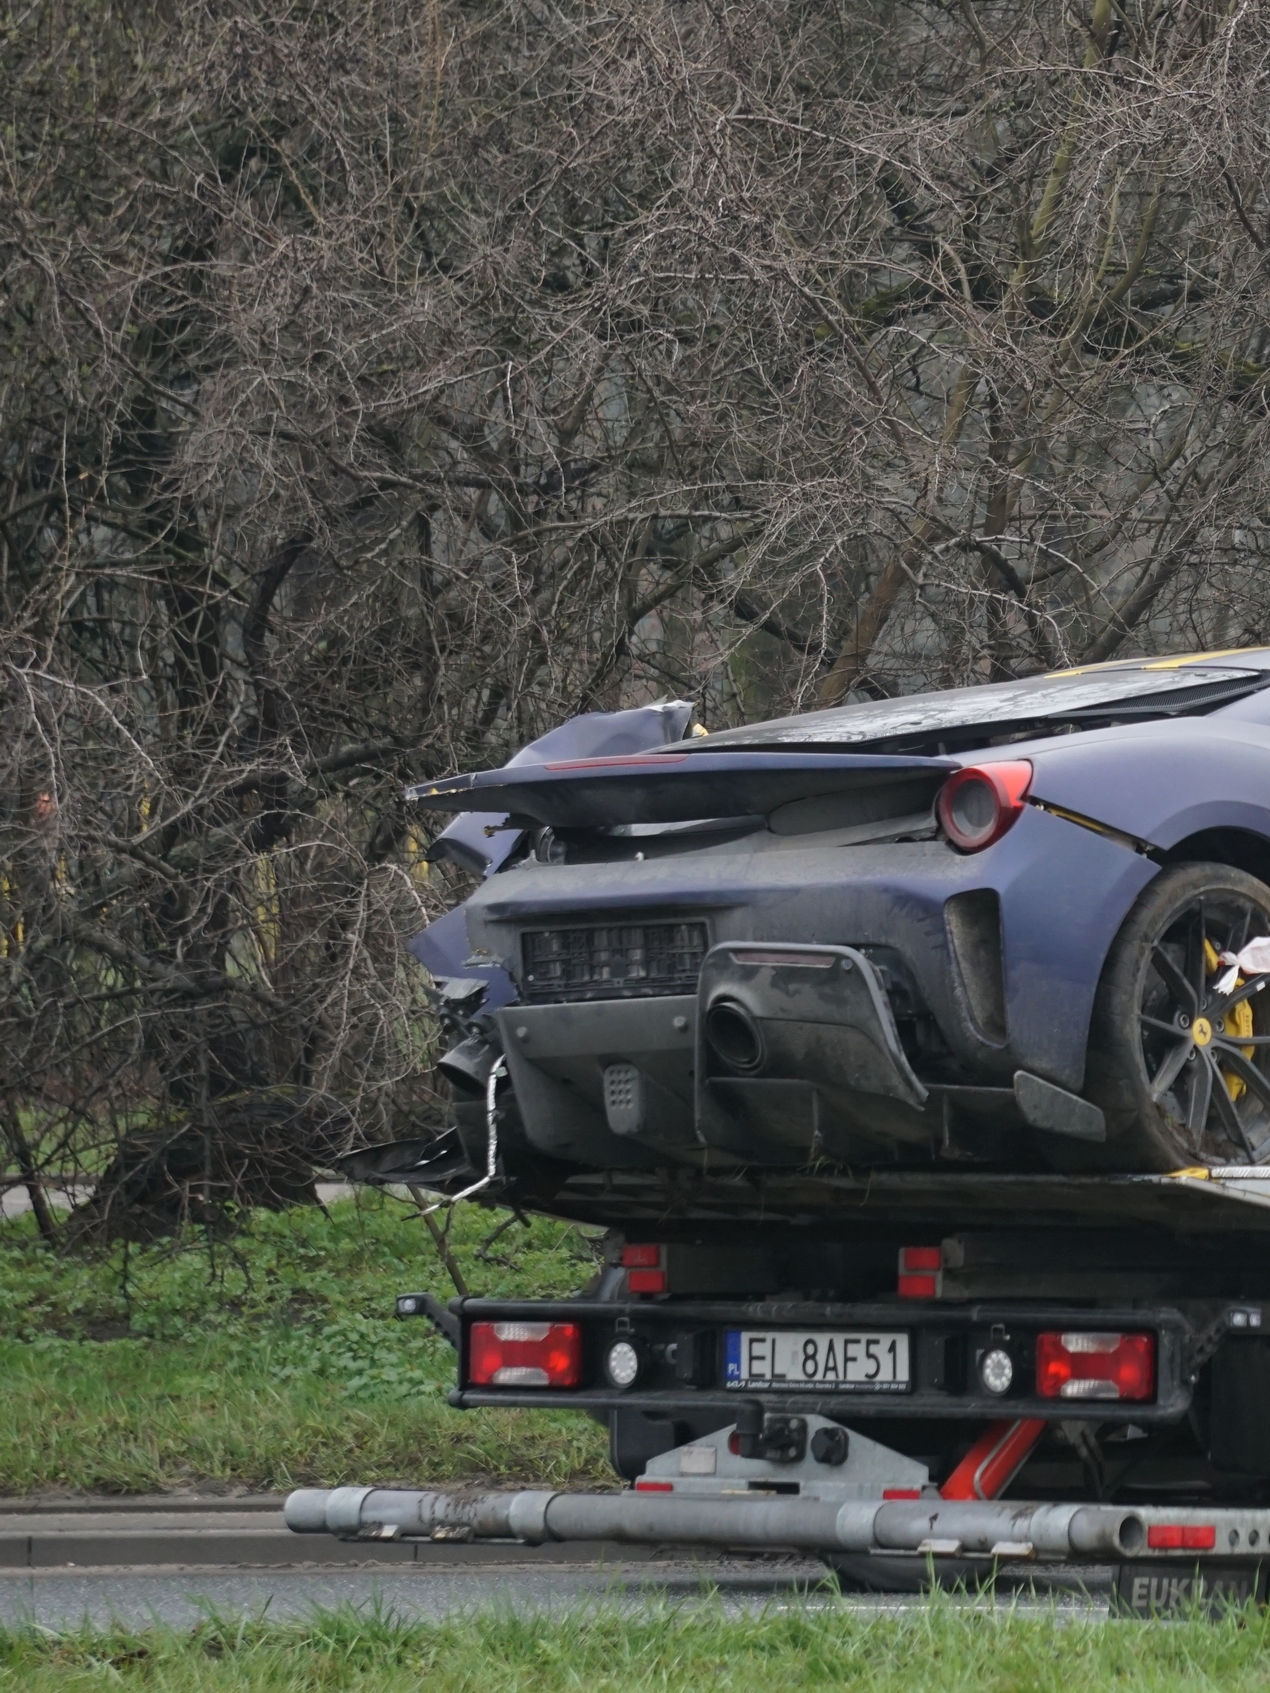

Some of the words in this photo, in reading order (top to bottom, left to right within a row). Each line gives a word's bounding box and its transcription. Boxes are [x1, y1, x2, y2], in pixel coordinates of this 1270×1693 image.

[728, 1362, 740, 1375] PL
[748, 1337, 786, 1379] EL
[802, 1337, 897, 1380] 8AF51
